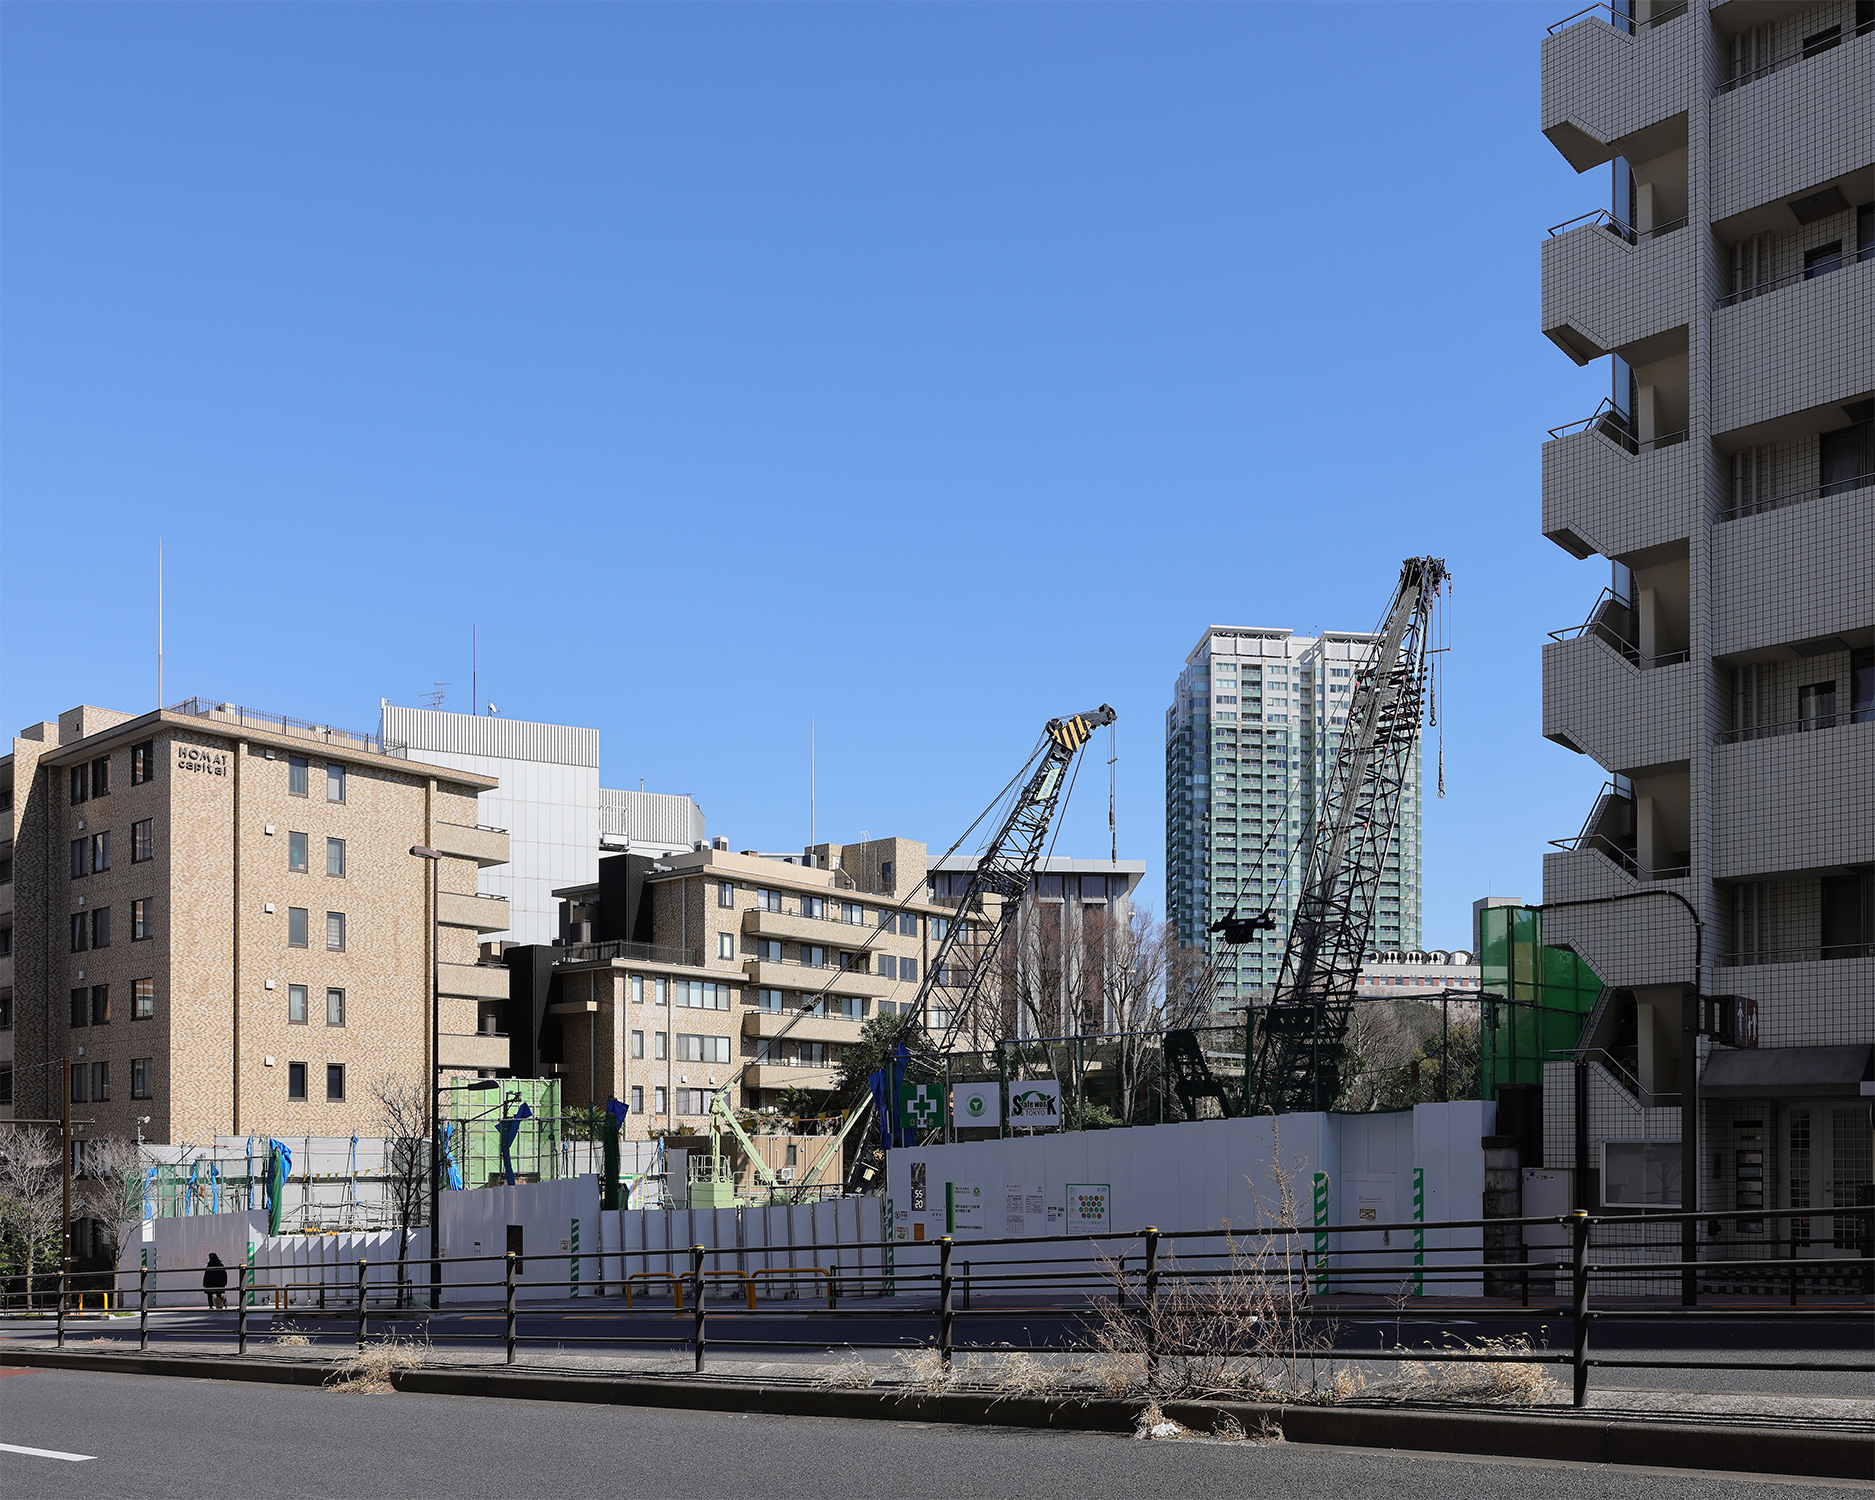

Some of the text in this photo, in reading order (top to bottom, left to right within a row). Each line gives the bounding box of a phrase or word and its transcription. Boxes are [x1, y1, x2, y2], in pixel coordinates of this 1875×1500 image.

[178, 746, 228, 766] HOMAT
[178, 760, 227, 777] capital
[1012, 1094, 1034, 1116] Safe
[914, 1199, 924, 1209] 20
